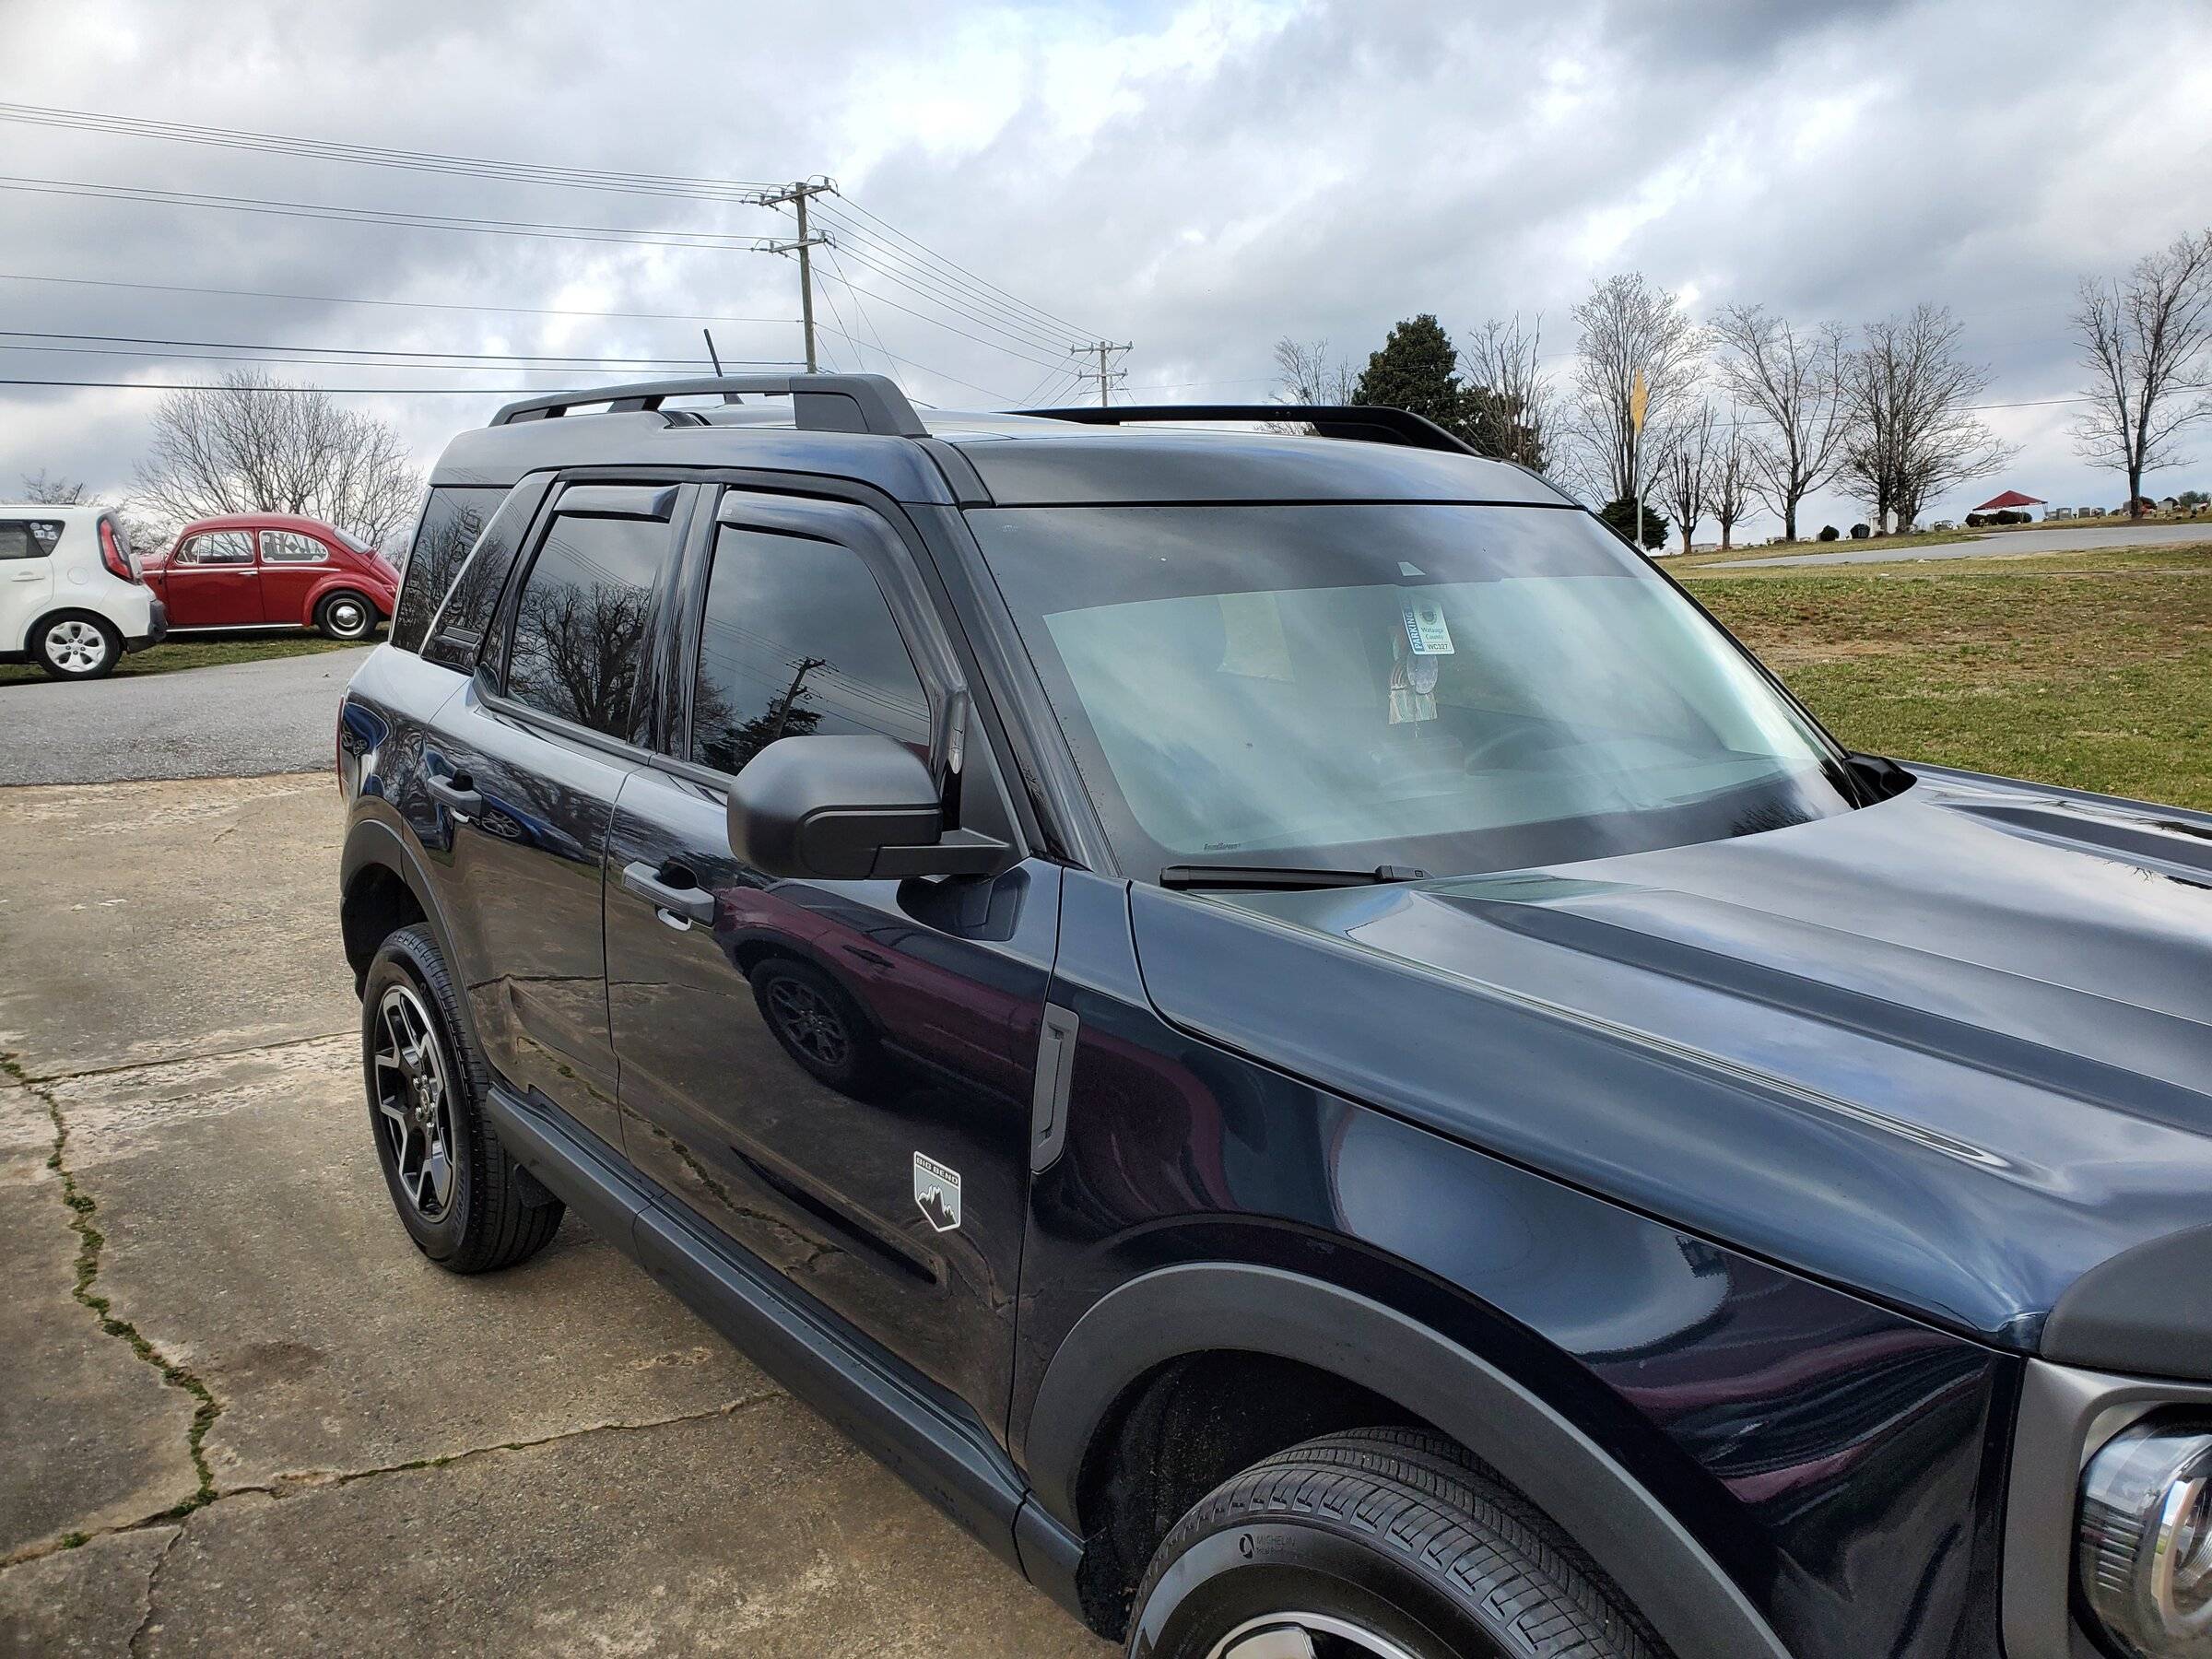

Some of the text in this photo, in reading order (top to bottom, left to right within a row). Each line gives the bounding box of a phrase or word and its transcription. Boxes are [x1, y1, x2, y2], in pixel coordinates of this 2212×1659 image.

[1406, 611, 1423, 649] PARKING
[916, 1157, 959, 1185] BIG BEND
